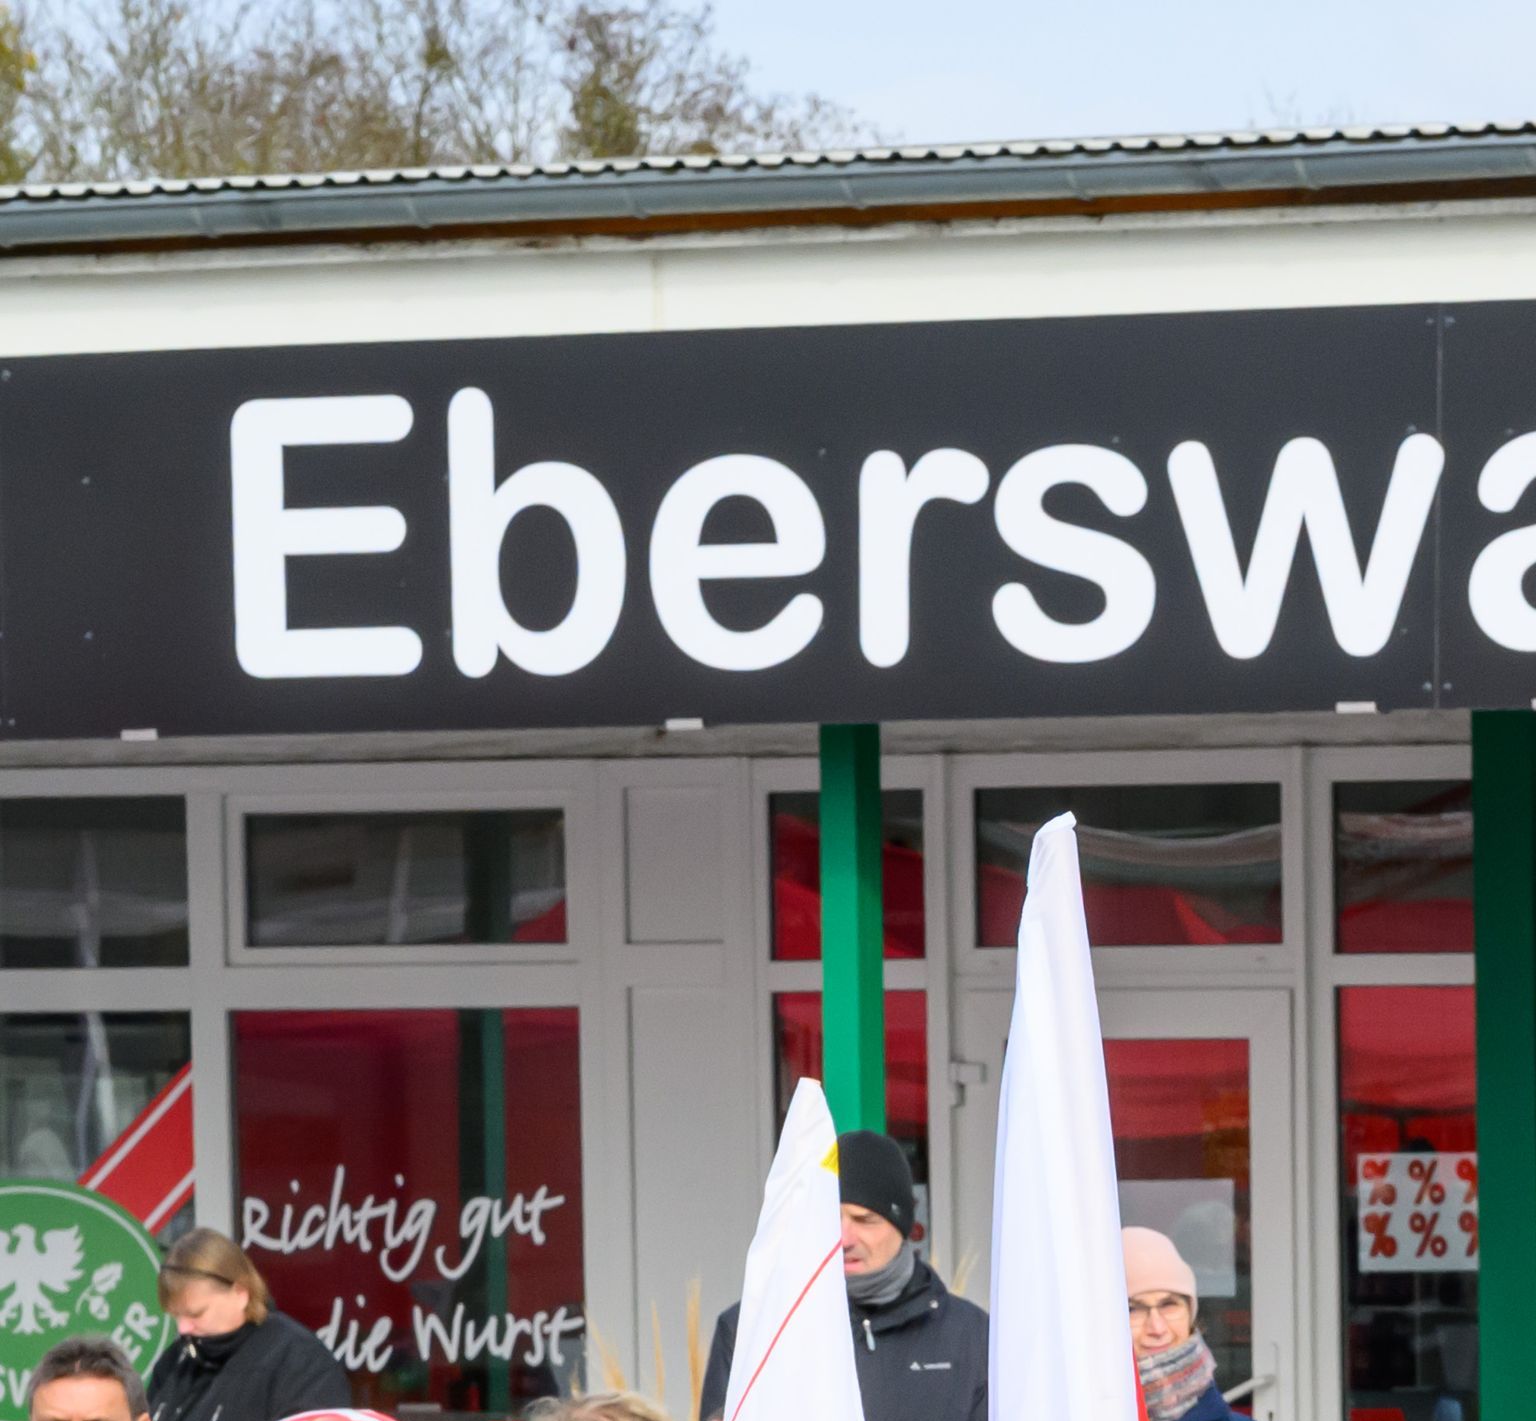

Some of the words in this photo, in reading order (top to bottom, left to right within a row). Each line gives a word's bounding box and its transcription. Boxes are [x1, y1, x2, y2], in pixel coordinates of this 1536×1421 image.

[241, 1163, 437, 1283] Richtig
[434, 1184, 566, 1281] gut
[316, 1293, 393, 1374] die
[411, 1301, 586, 1368] Wurst
